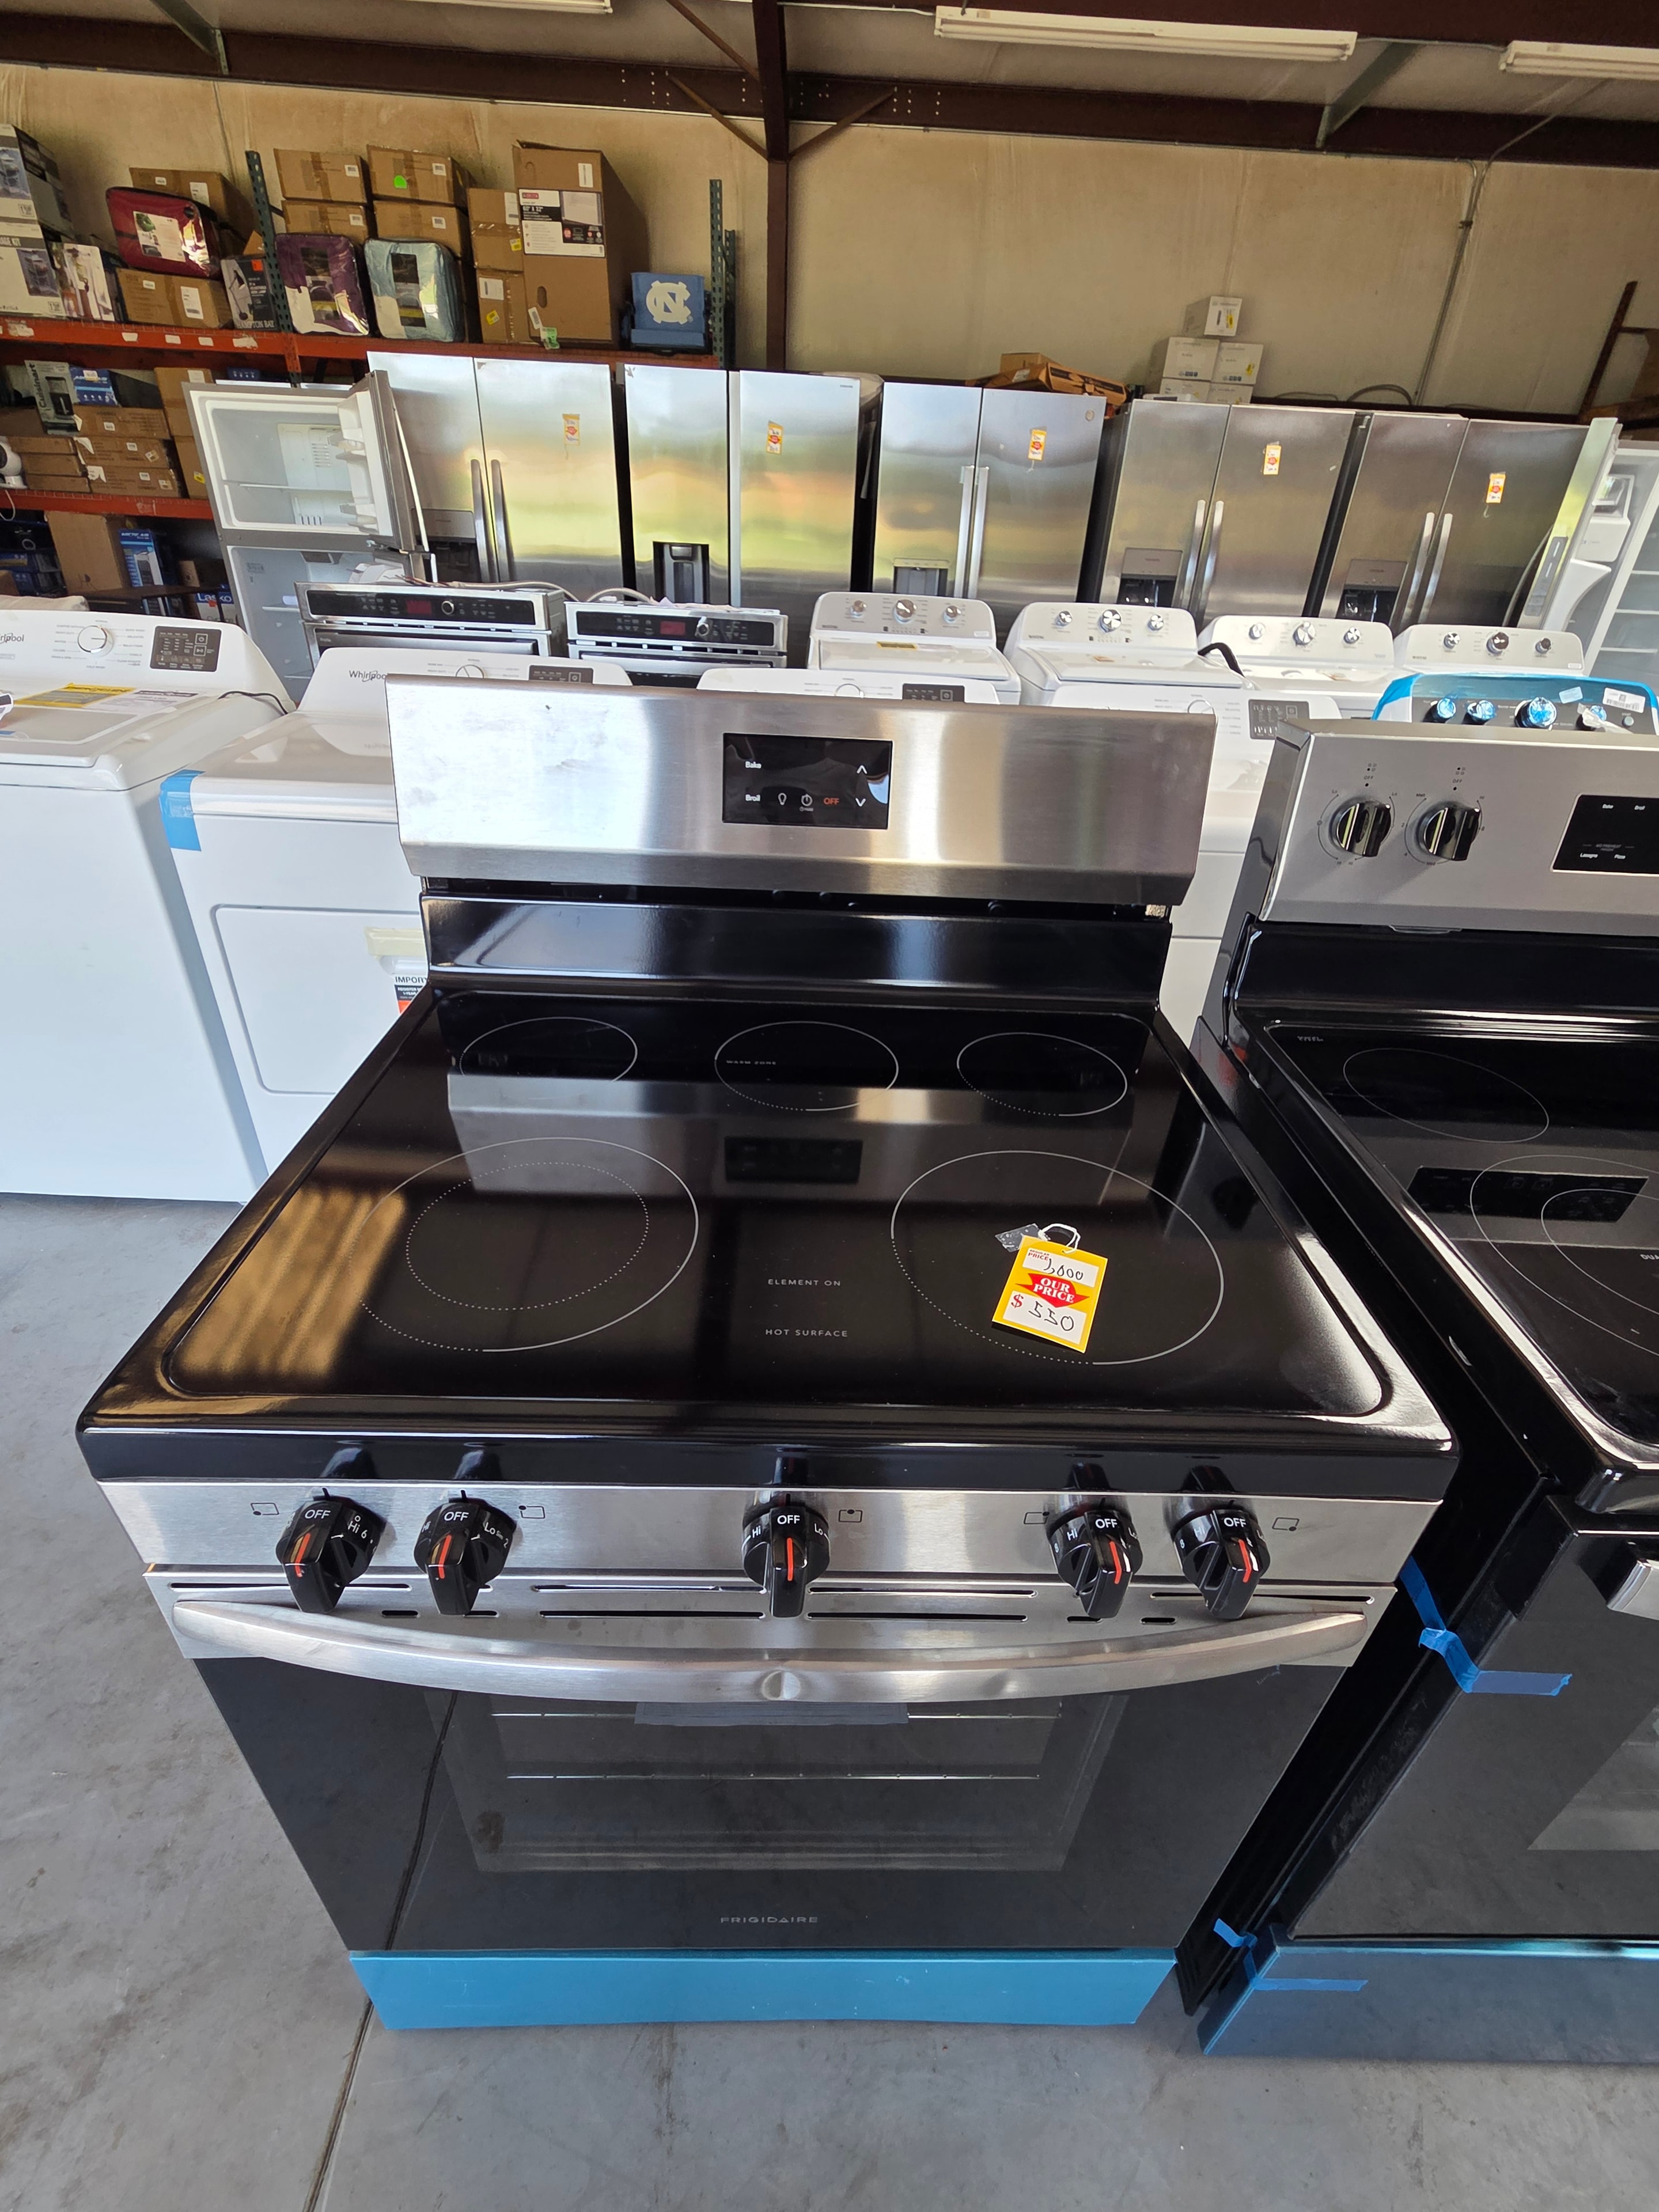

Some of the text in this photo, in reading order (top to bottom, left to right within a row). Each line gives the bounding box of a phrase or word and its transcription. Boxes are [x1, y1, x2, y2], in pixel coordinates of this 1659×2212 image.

[264, 320, 275, 328] BAY
[29, 363, 47, 408] Cuisinart
[0, 633, 24, 643] rlpool
[349, 670, 387, 682] Whirlpoo
[745, 761, 762, 769] Bake
[745, 794, 761, 802] Broil
[395, 976, 427, 984] IMPOR
[1028, 1252, 1049, 1261] PRICE
[1040, 1277, 1071, 1293] OUR
[1033, 1283, 1075, 1304] PRICE
[1011, 1294, 1074, 1331] $ 550
[795, 1329, 849, 1337] SURFACE
[304, 1509, 331, 1519] OFF
[444, 1511, 469, 1521] OFF
[777, 1514, 801, 1525] OFF
[484, 1521, 495, 1535] Lo
[1095, 1518, 1118, 1529] OFF
[1224, 1517, 1247, 1528] OFF
[347, 1520, 369, 1539] Hi 6
[752, 1525, 761, 1538] Hi
[813, 1523, 823, 1535] Lo
[1067, 1528, 1078, 1541] Hi
[1054, 1543, 1059, 1553] 8
[1180, 1539, 1185, 1548] 8
